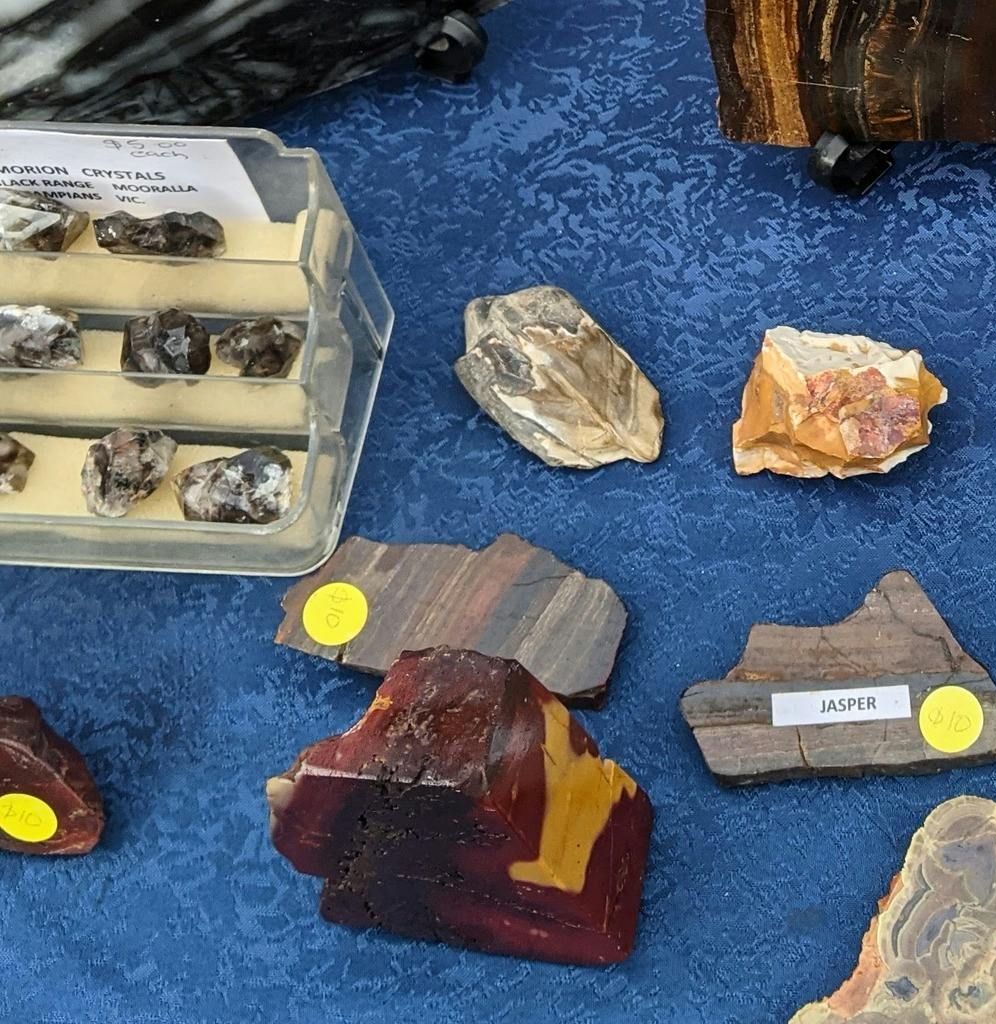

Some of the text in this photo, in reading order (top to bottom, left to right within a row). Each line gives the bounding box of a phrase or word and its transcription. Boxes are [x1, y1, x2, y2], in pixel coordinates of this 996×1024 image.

[82, 168, 166, 181] CRYSTALS
[0, 179, 40, 187] LACK
[112, 183, 198, 193] MOORALLA
[115, 194, 145, 204] VIC.
[820, 696, 877, 714] JASPER
[928, 707, 972, 733] $10
